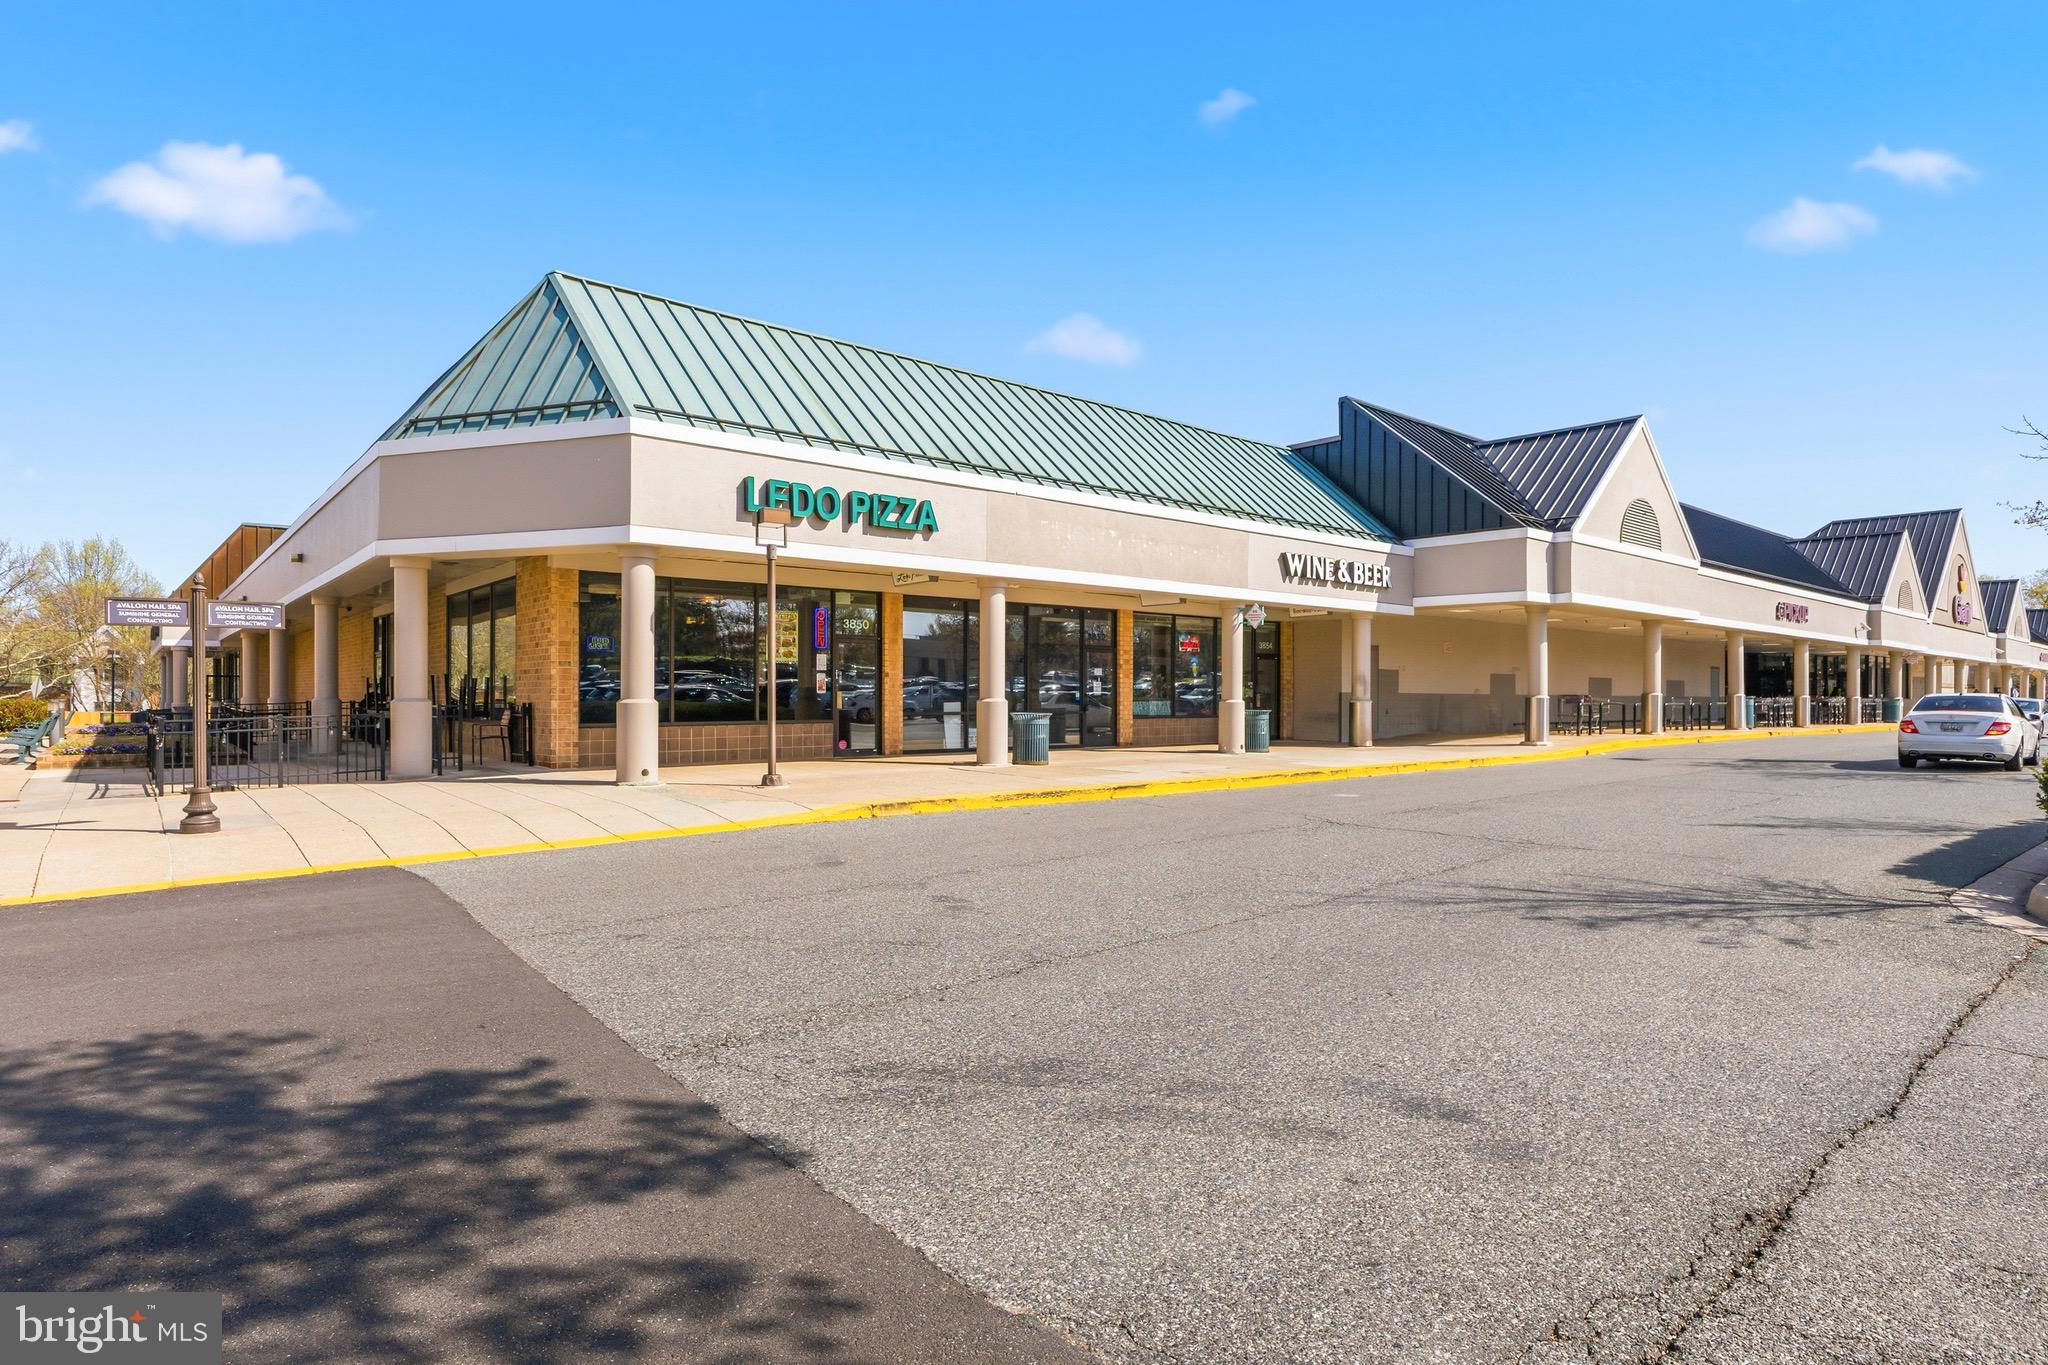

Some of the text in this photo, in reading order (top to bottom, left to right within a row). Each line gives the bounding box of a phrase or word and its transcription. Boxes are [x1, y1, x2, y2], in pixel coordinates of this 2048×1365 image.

[744, 476, 939, 532] LEDO PIZZA
[1284, 552, 1393, 589] WINE & BEER
[116, 602, 147, 610] AVALON
[843, 618, 870, 630] 3850
